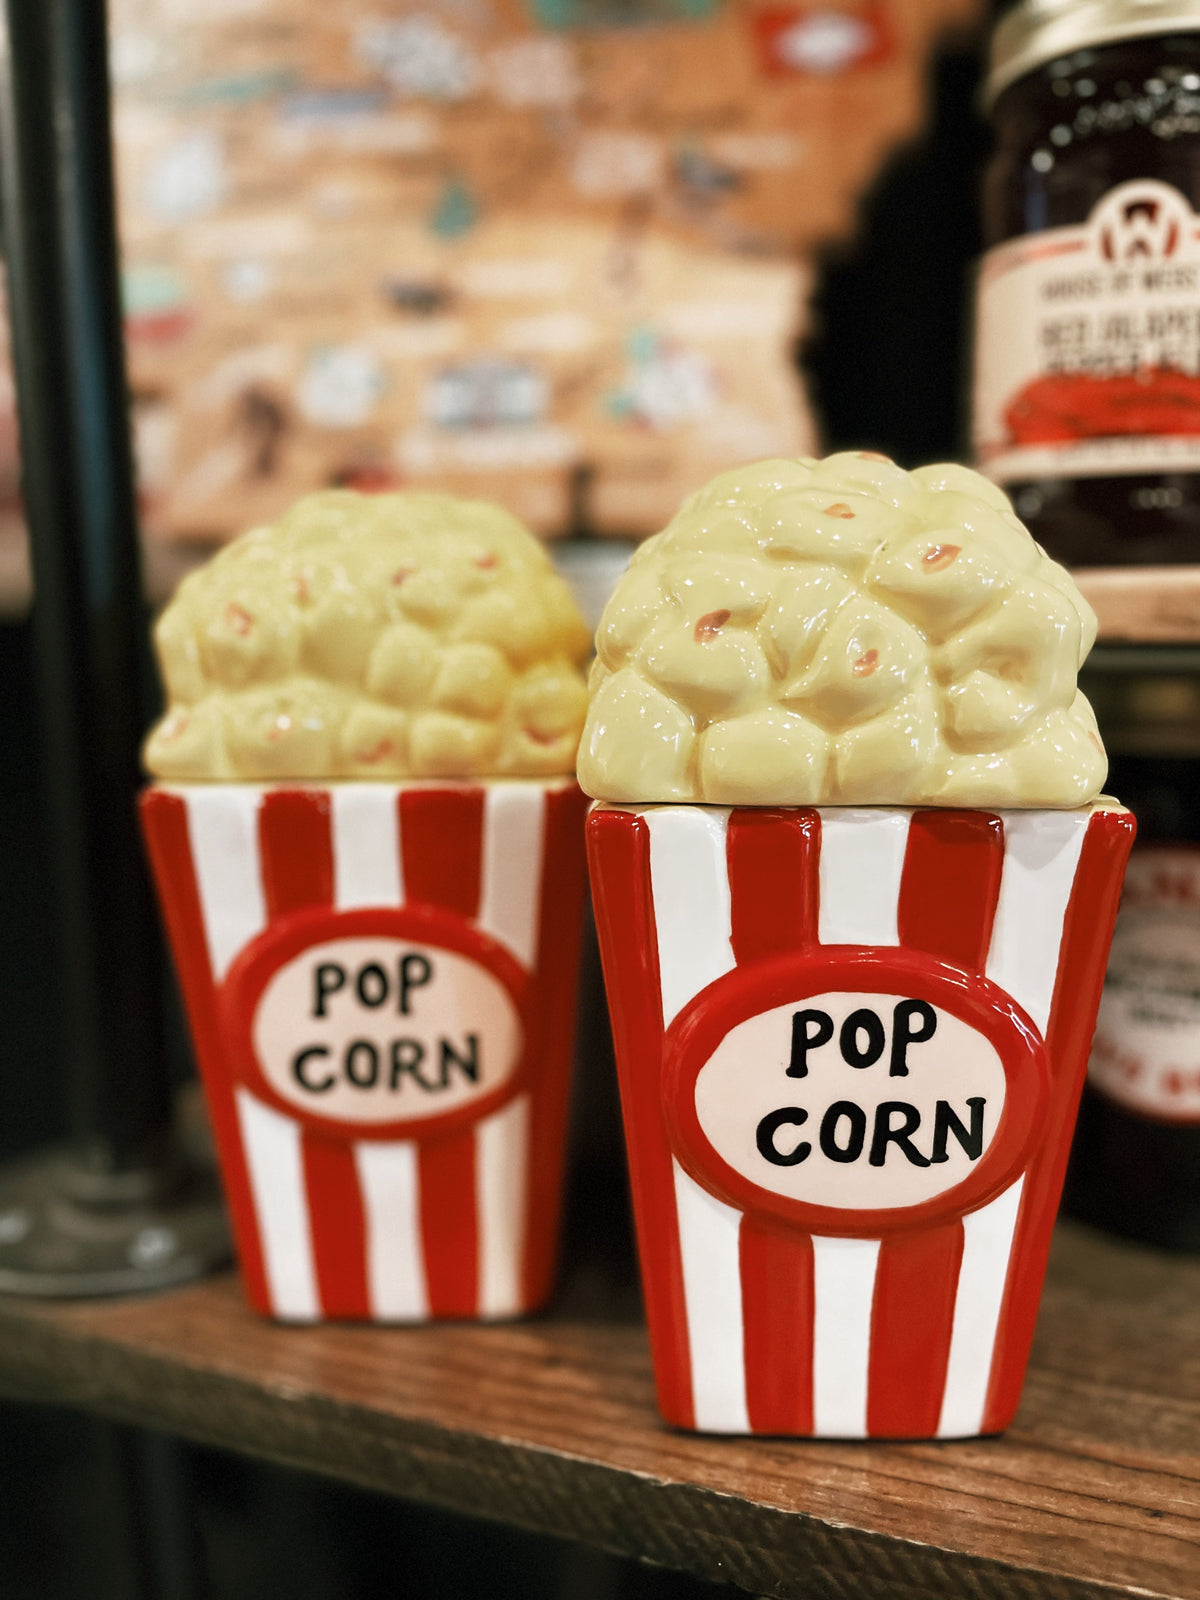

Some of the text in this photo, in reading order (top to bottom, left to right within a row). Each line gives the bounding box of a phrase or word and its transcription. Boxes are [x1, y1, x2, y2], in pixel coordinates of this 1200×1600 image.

[312, 951, 433, 1018] POP
[291, 1033, 479, 1093] CORN
[786, 998, 937, 1079] POP
[756, 1097, 986, 1167] CORN
